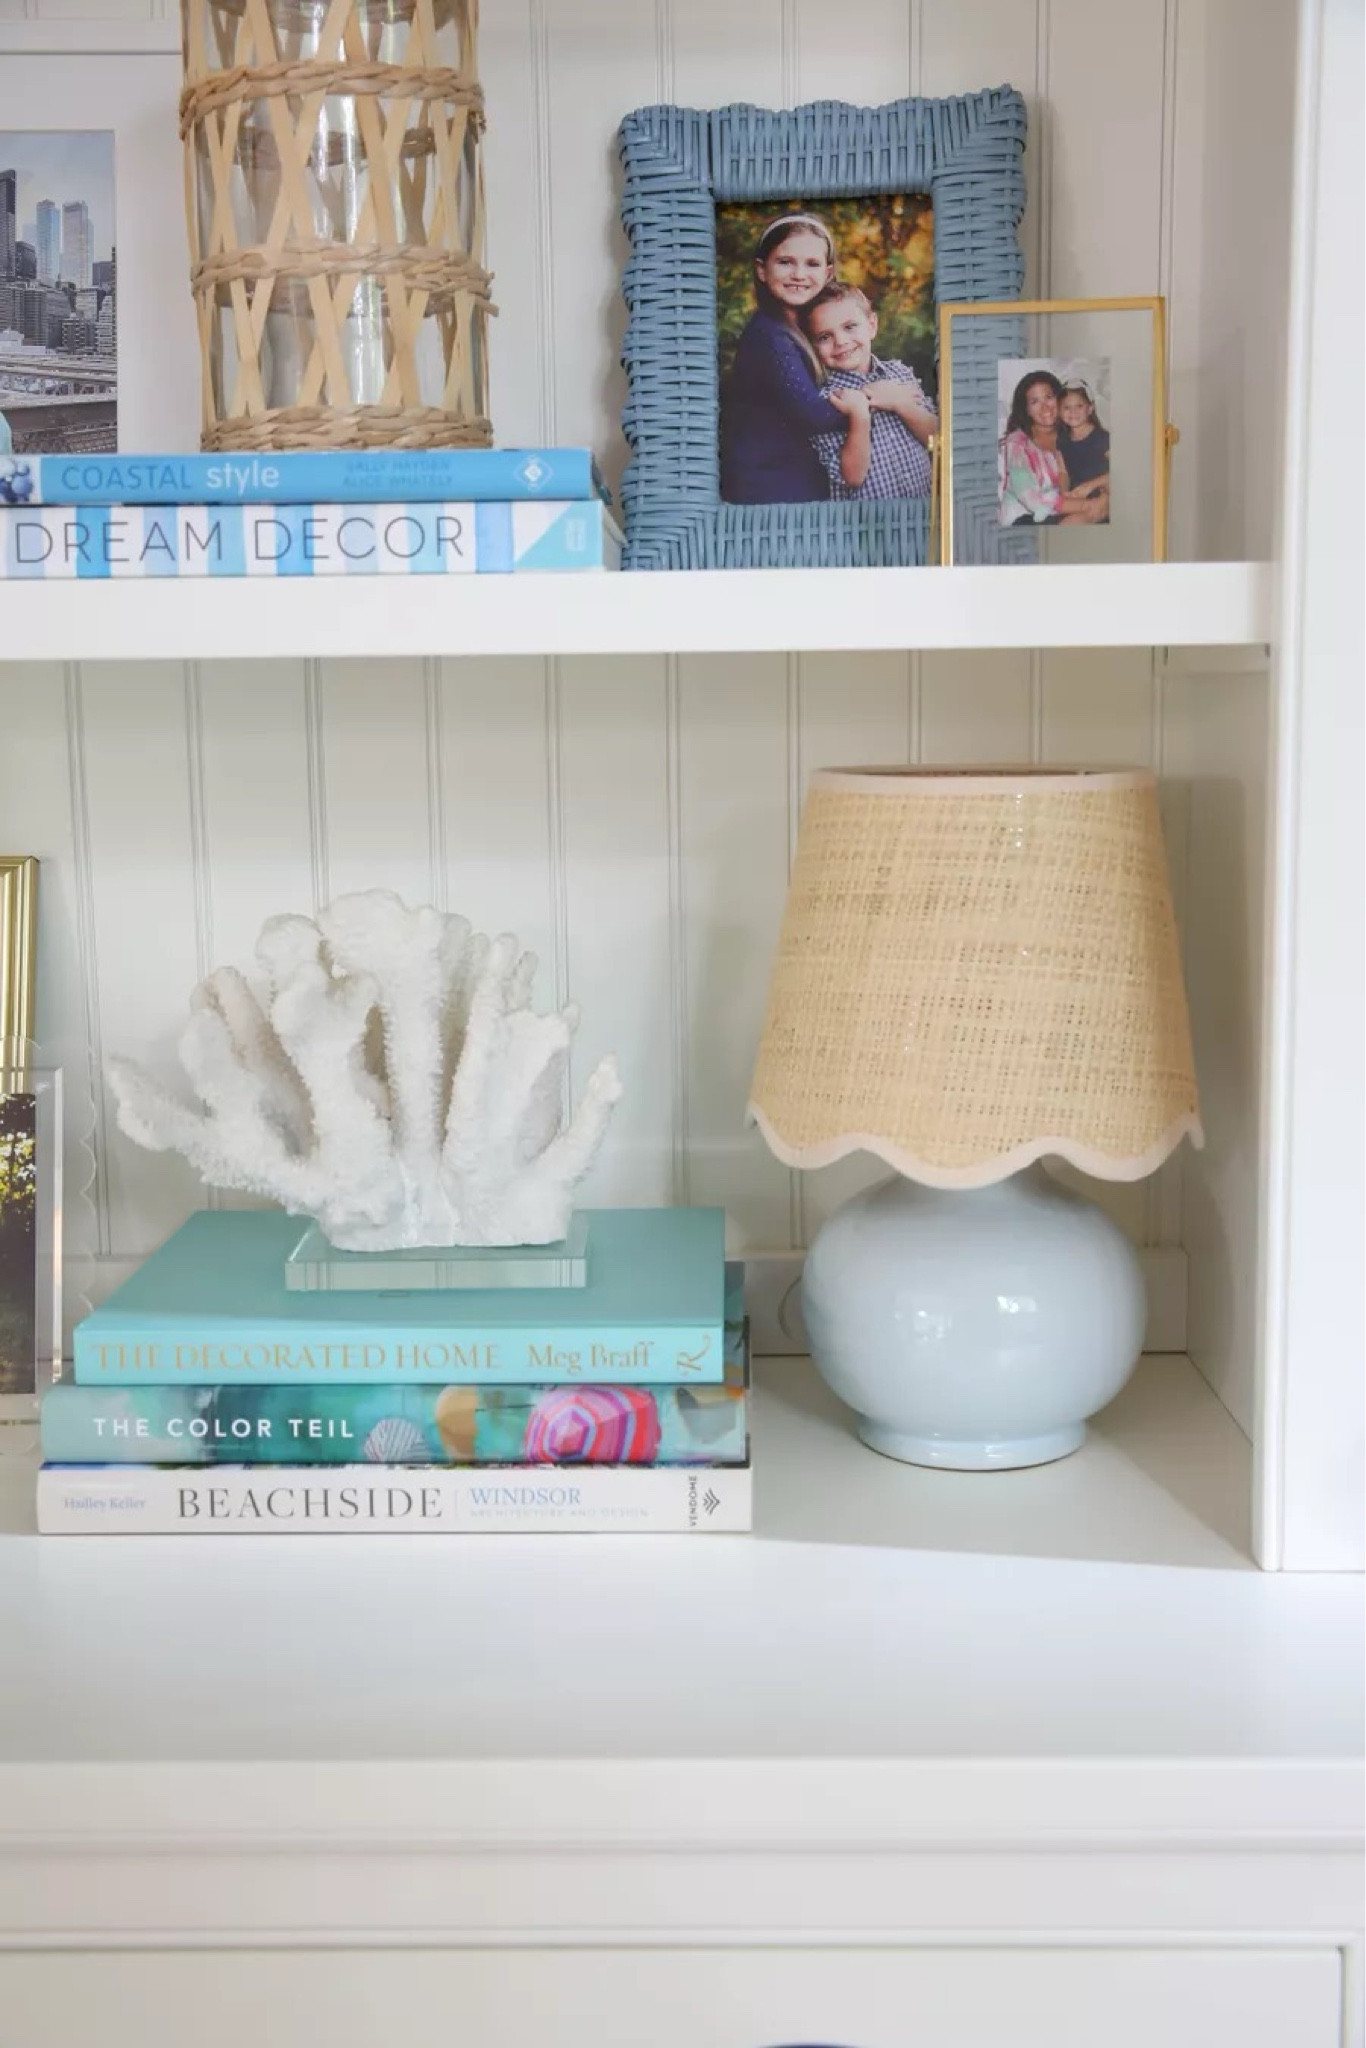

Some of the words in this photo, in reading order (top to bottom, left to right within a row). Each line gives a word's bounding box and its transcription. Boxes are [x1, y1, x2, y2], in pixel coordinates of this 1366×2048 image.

[62, 465, 192, 491] COASTAL
[206, 460, 280, 494] style
[15, 521, 224, 564] DREAM
[254, 517, 464, 561] DECOR
[95, 1344, 160, 1369] THE
[173, 1344, 385, 1369] DECORATED
[394, 1343, 500, 1368] HOME
[527, 1345, 583, 1376] Meg
[588, 1342, 657, 1368] Braff
[93, 1418, 149, 1437] THE
[167, 1418, 272, 1438] COLOR
[288, 1419, 353, 1438] TEIL
[177, 1488, 443, 1518] BEACHSIDE
[470, 1487, 581, 1506] WINDSOR
[688, 1475, 697, 1526] VENDOME
